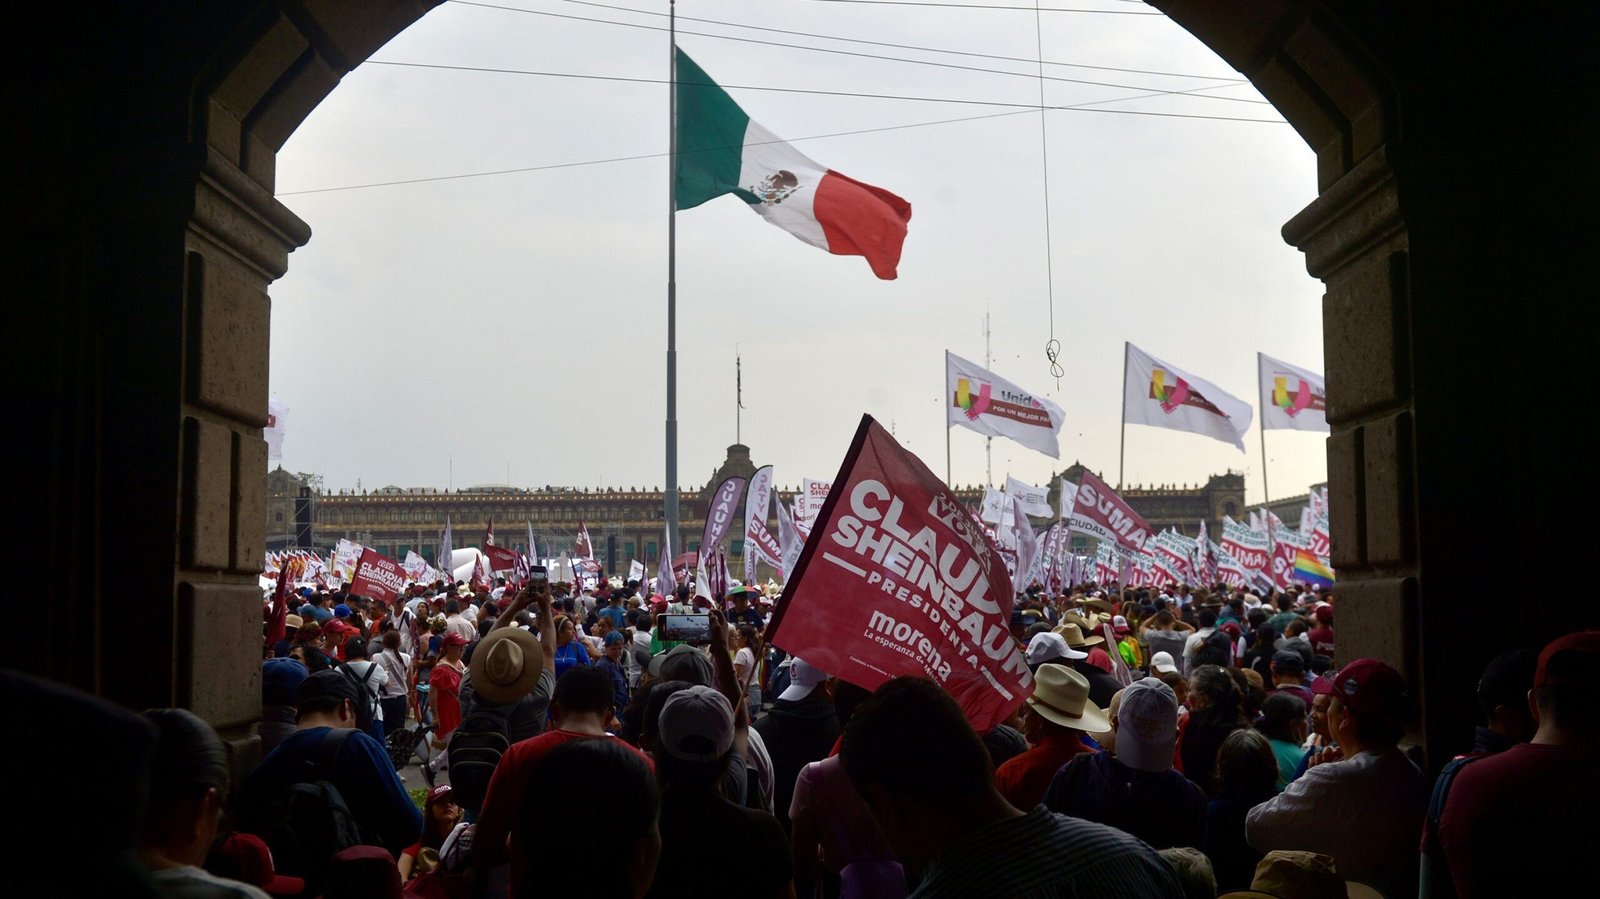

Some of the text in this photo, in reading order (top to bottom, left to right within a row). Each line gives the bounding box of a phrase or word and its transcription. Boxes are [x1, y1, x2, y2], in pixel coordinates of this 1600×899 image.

[750, 520, 782, 559] SUM
[1078, 484, 1146, 549] SUMA
[361, 562, 403, 586] CLAUDIA
[831, 514, 1032, 689] SHEINBAUM
[864, 629, 874, 639] La
[875, 636, 916, 658] esperanza
[868, 570, 978, 669] PRESIDENTA
[868, 610, 952, 682] morena
